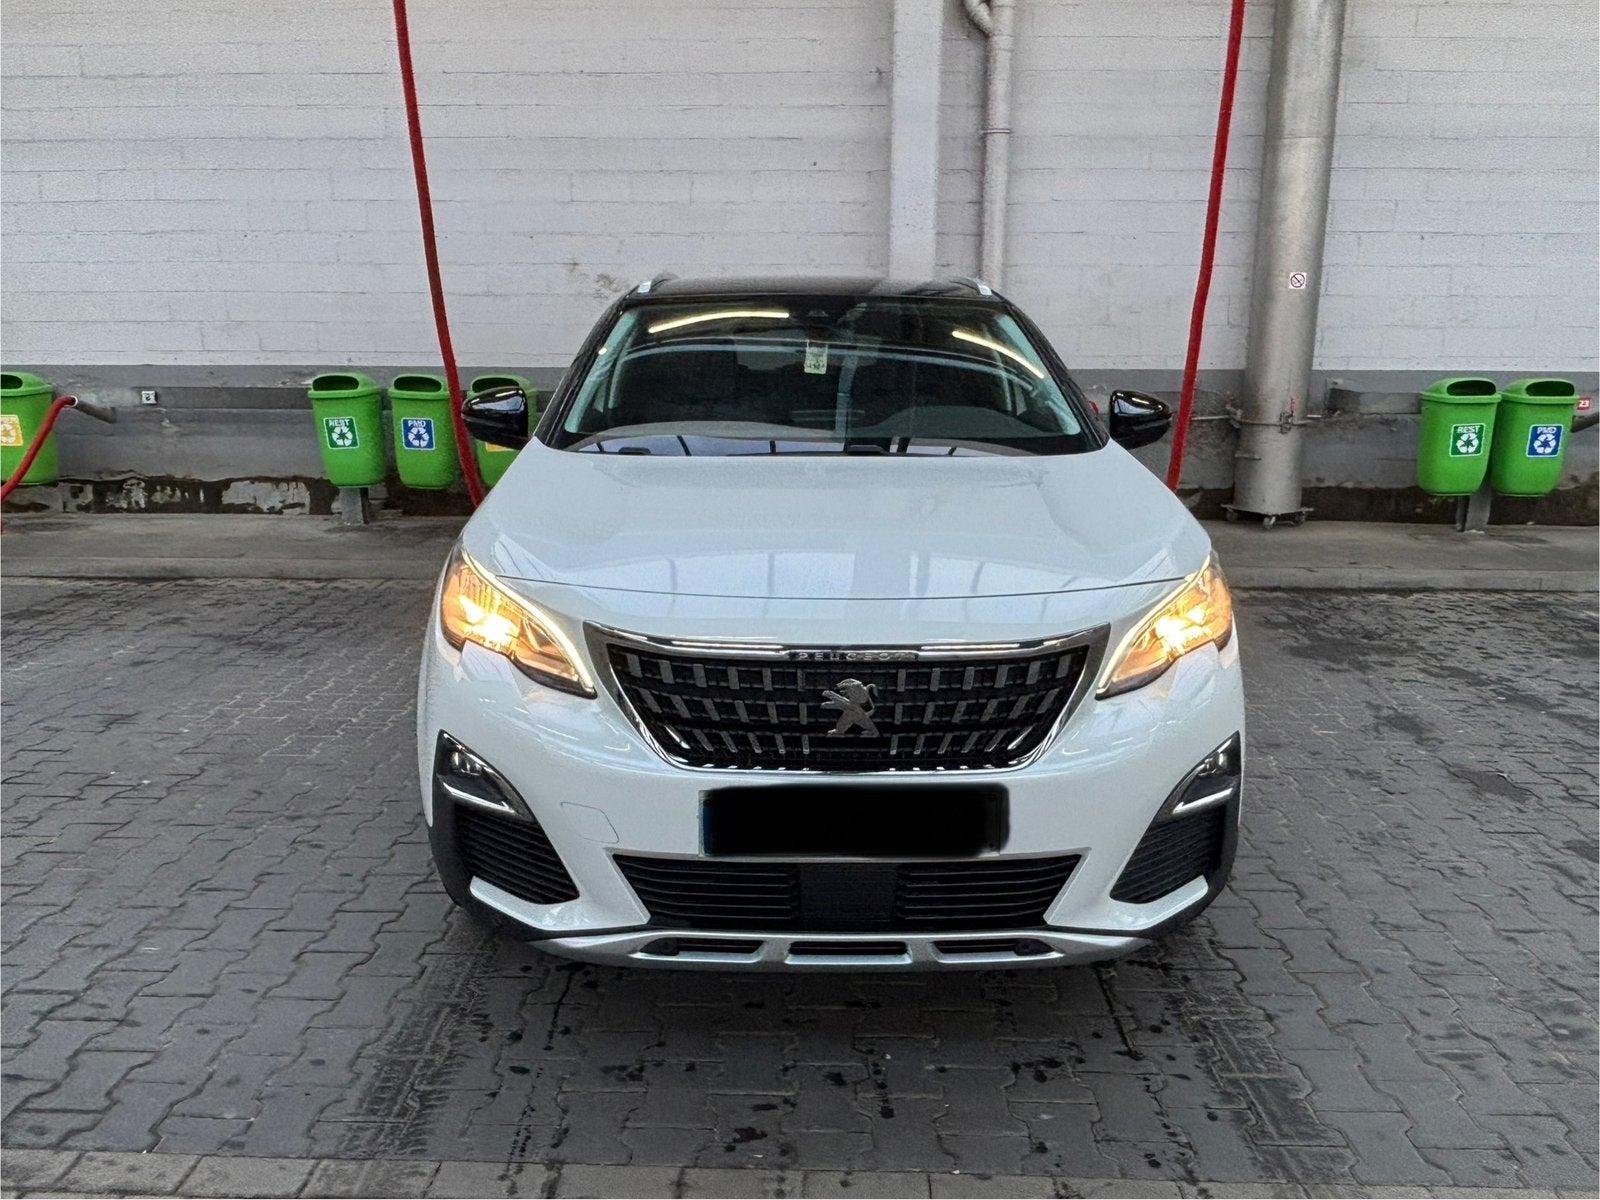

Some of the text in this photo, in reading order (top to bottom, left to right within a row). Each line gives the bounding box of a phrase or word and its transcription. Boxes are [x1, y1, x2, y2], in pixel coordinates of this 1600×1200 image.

[1578, 399, 1590, 407] 23
[328, 418, 350, 428] REST
[408, 419, 426, 428] PMD
[1456, 425, 1480, 434] REST
[1537, 426, 1557, 434] PMD
